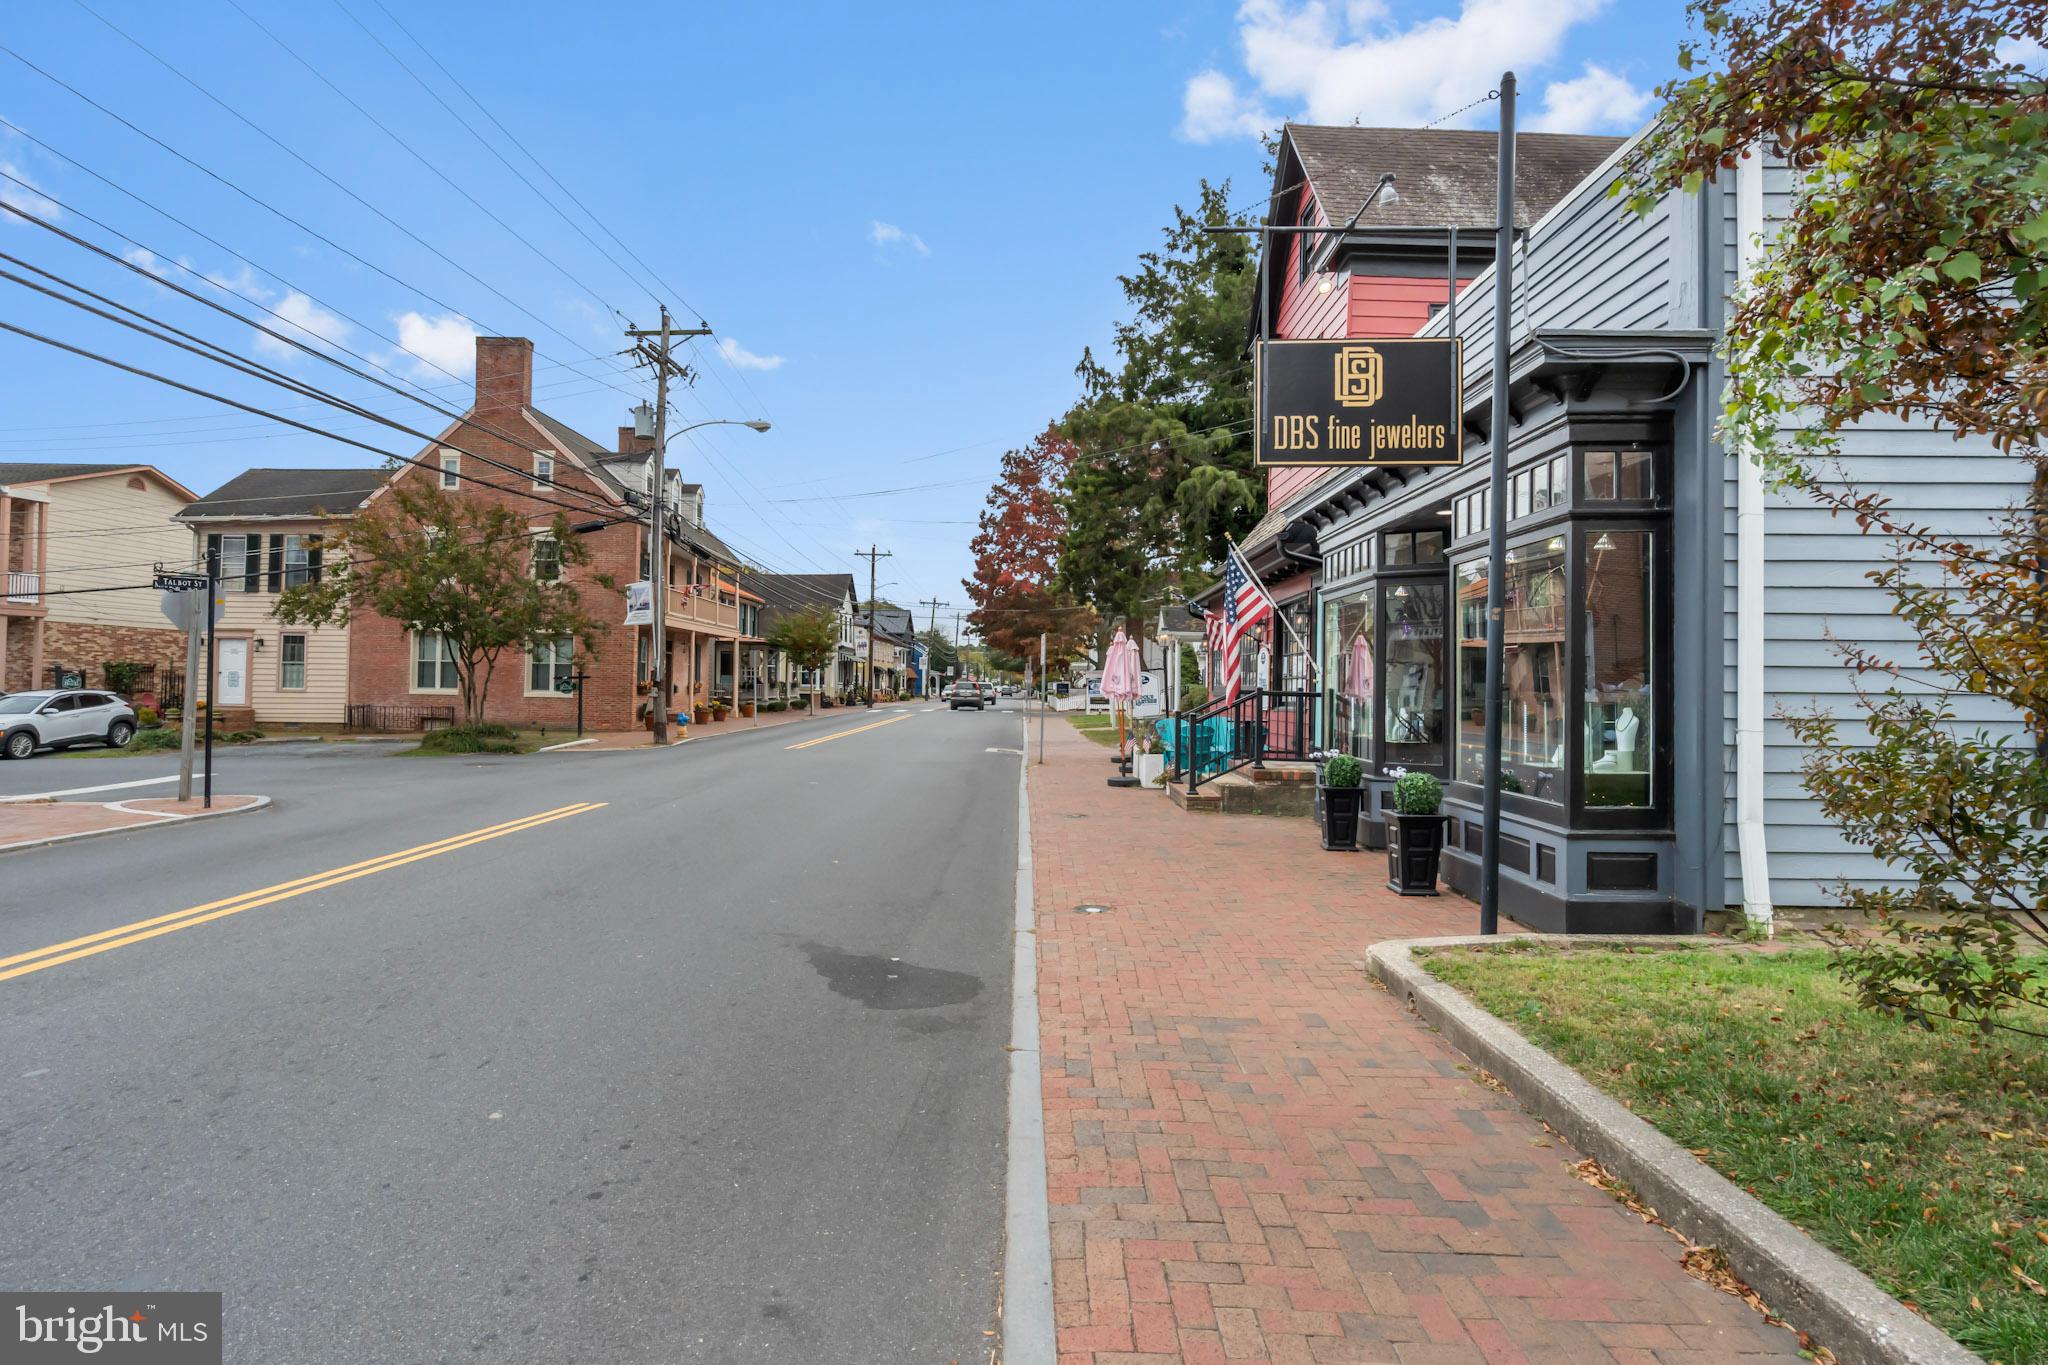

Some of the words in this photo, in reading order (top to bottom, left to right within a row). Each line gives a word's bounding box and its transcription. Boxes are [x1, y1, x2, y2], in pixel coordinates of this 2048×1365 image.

[1274, 415, 1319, 449] DBS
[1328, 415, 1361, 449] fine
[1369, 414, 1445, 460] jewelers
[163, 578, 191, 586] TALBOT
